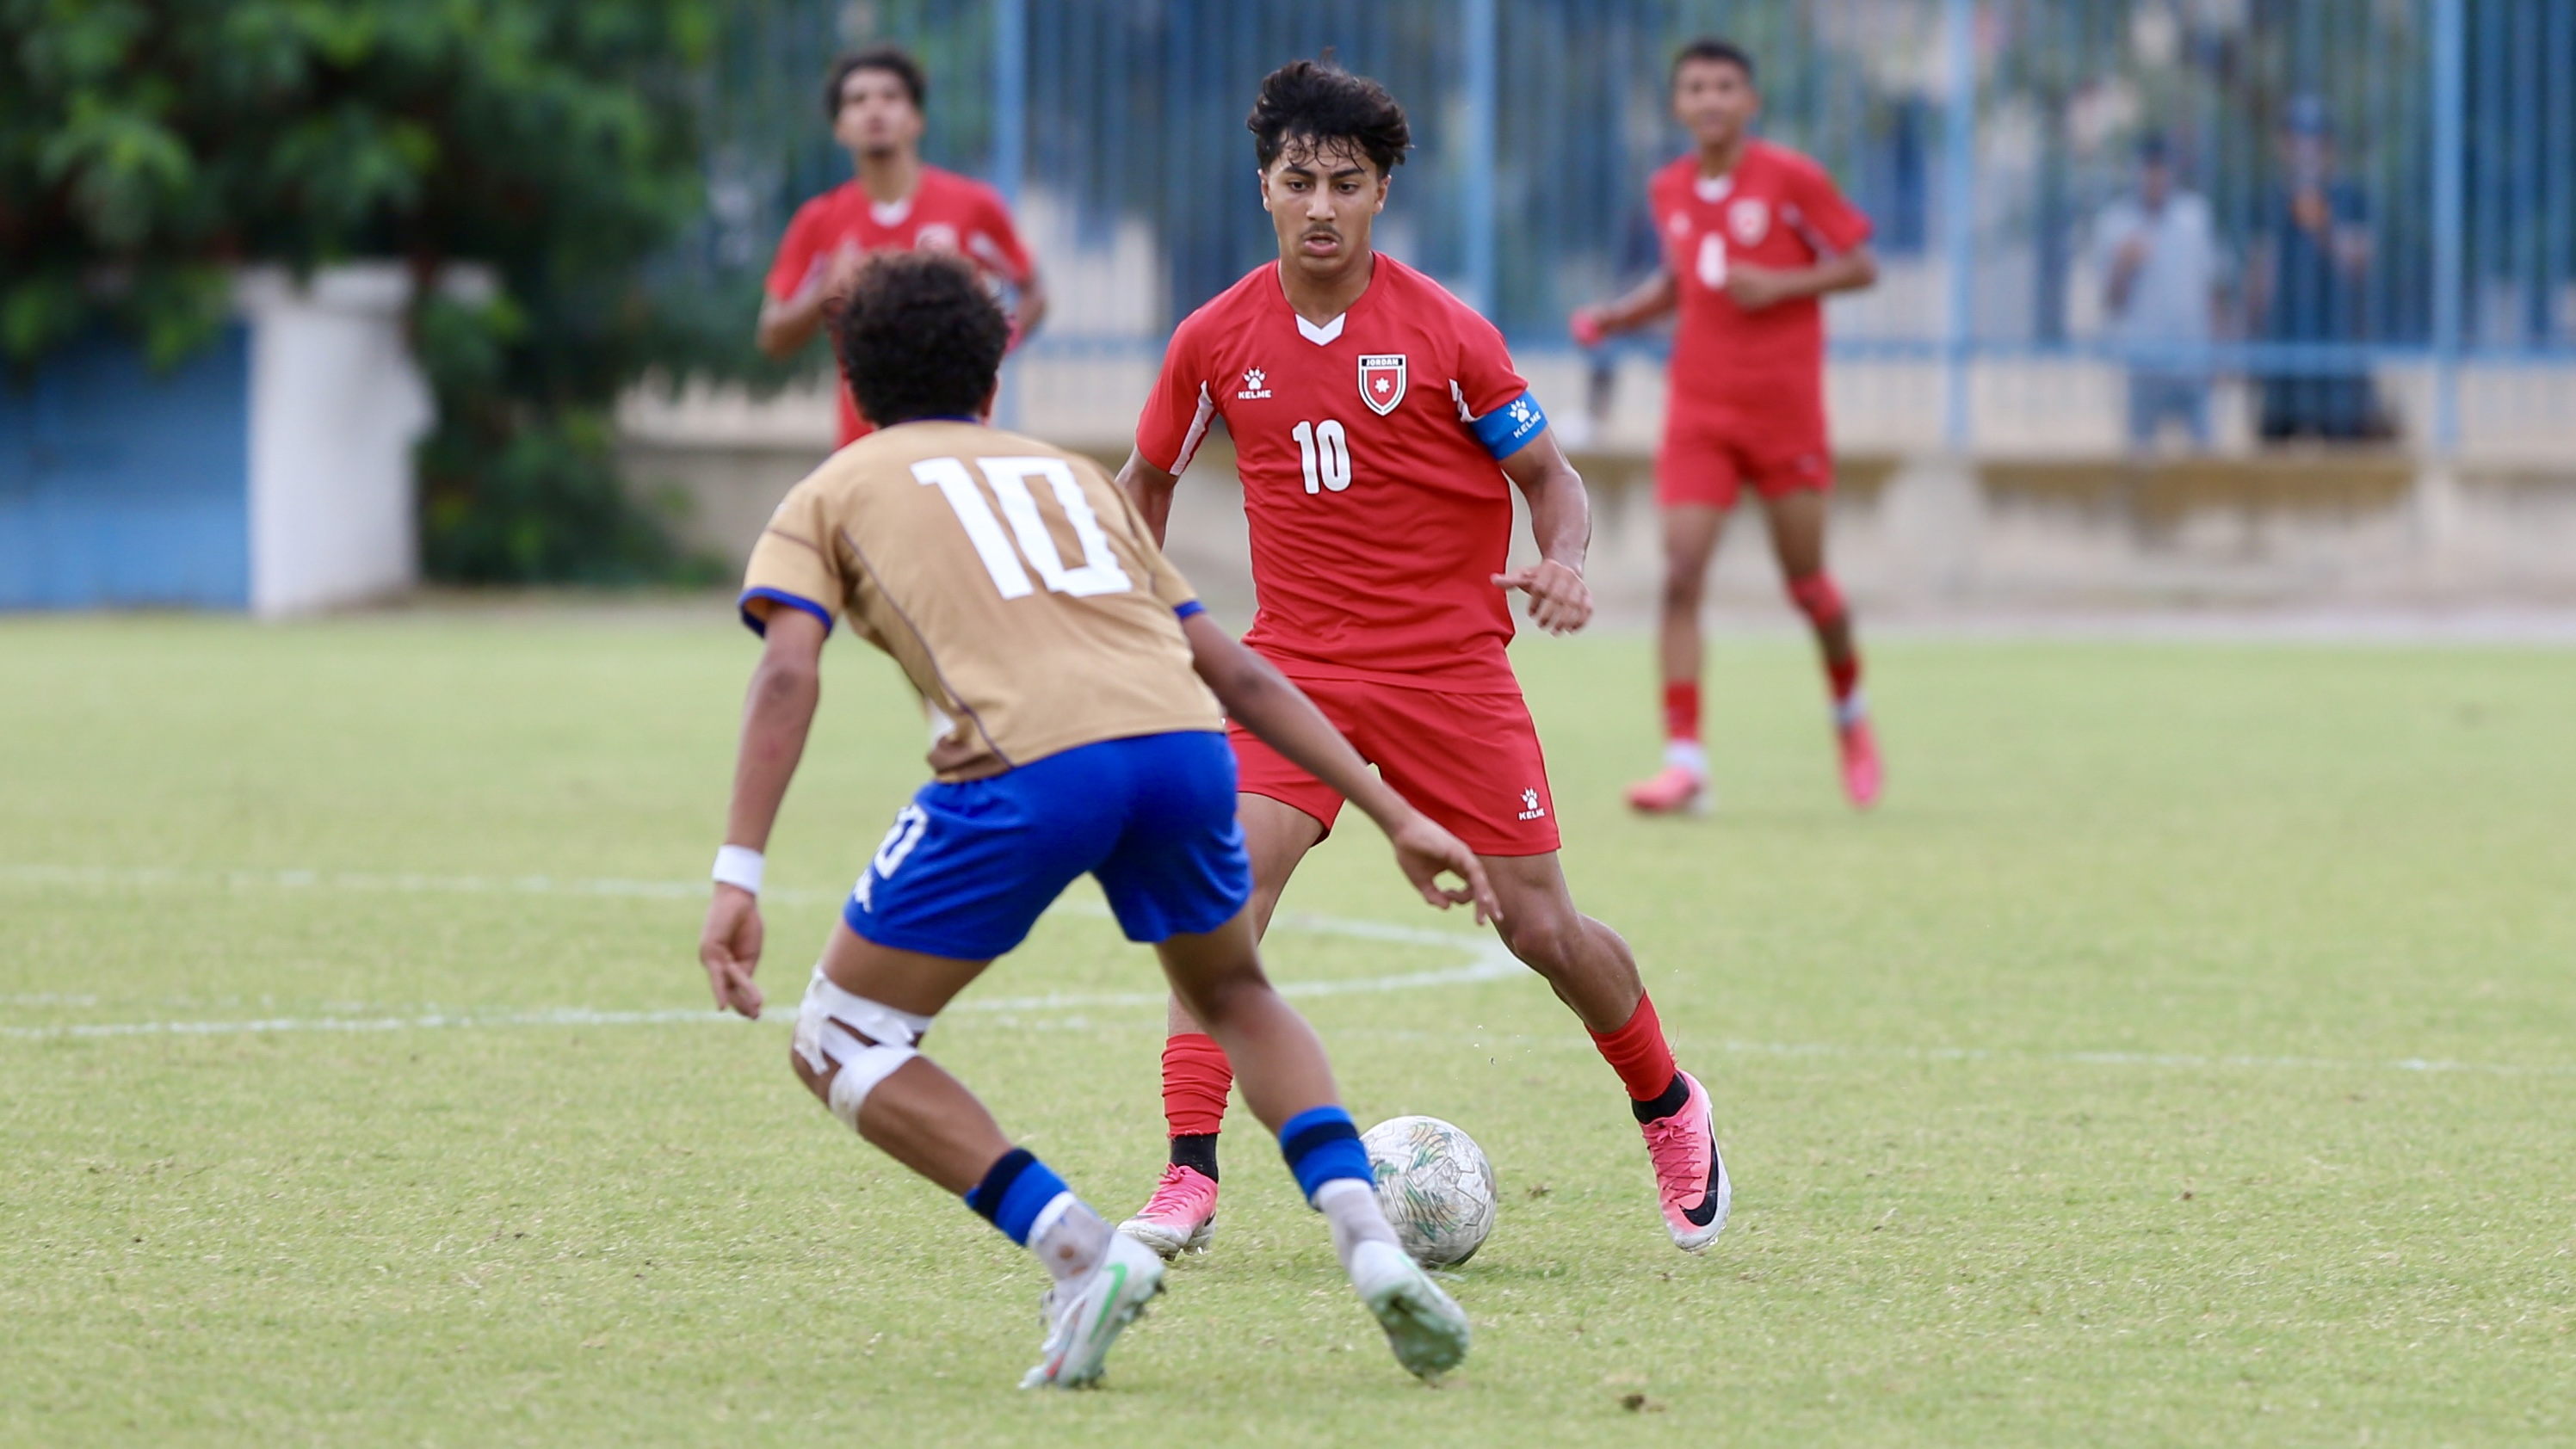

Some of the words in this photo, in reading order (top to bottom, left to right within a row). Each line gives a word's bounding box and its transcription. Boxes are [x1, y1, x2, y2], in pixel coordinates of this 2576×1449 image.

[1238, 390, 1272, 399] KELME
[1513, 410, 1541, 439] KELME
[1292, 419, 1351, 494] 10
[909, 457, 1133, 600] 10
